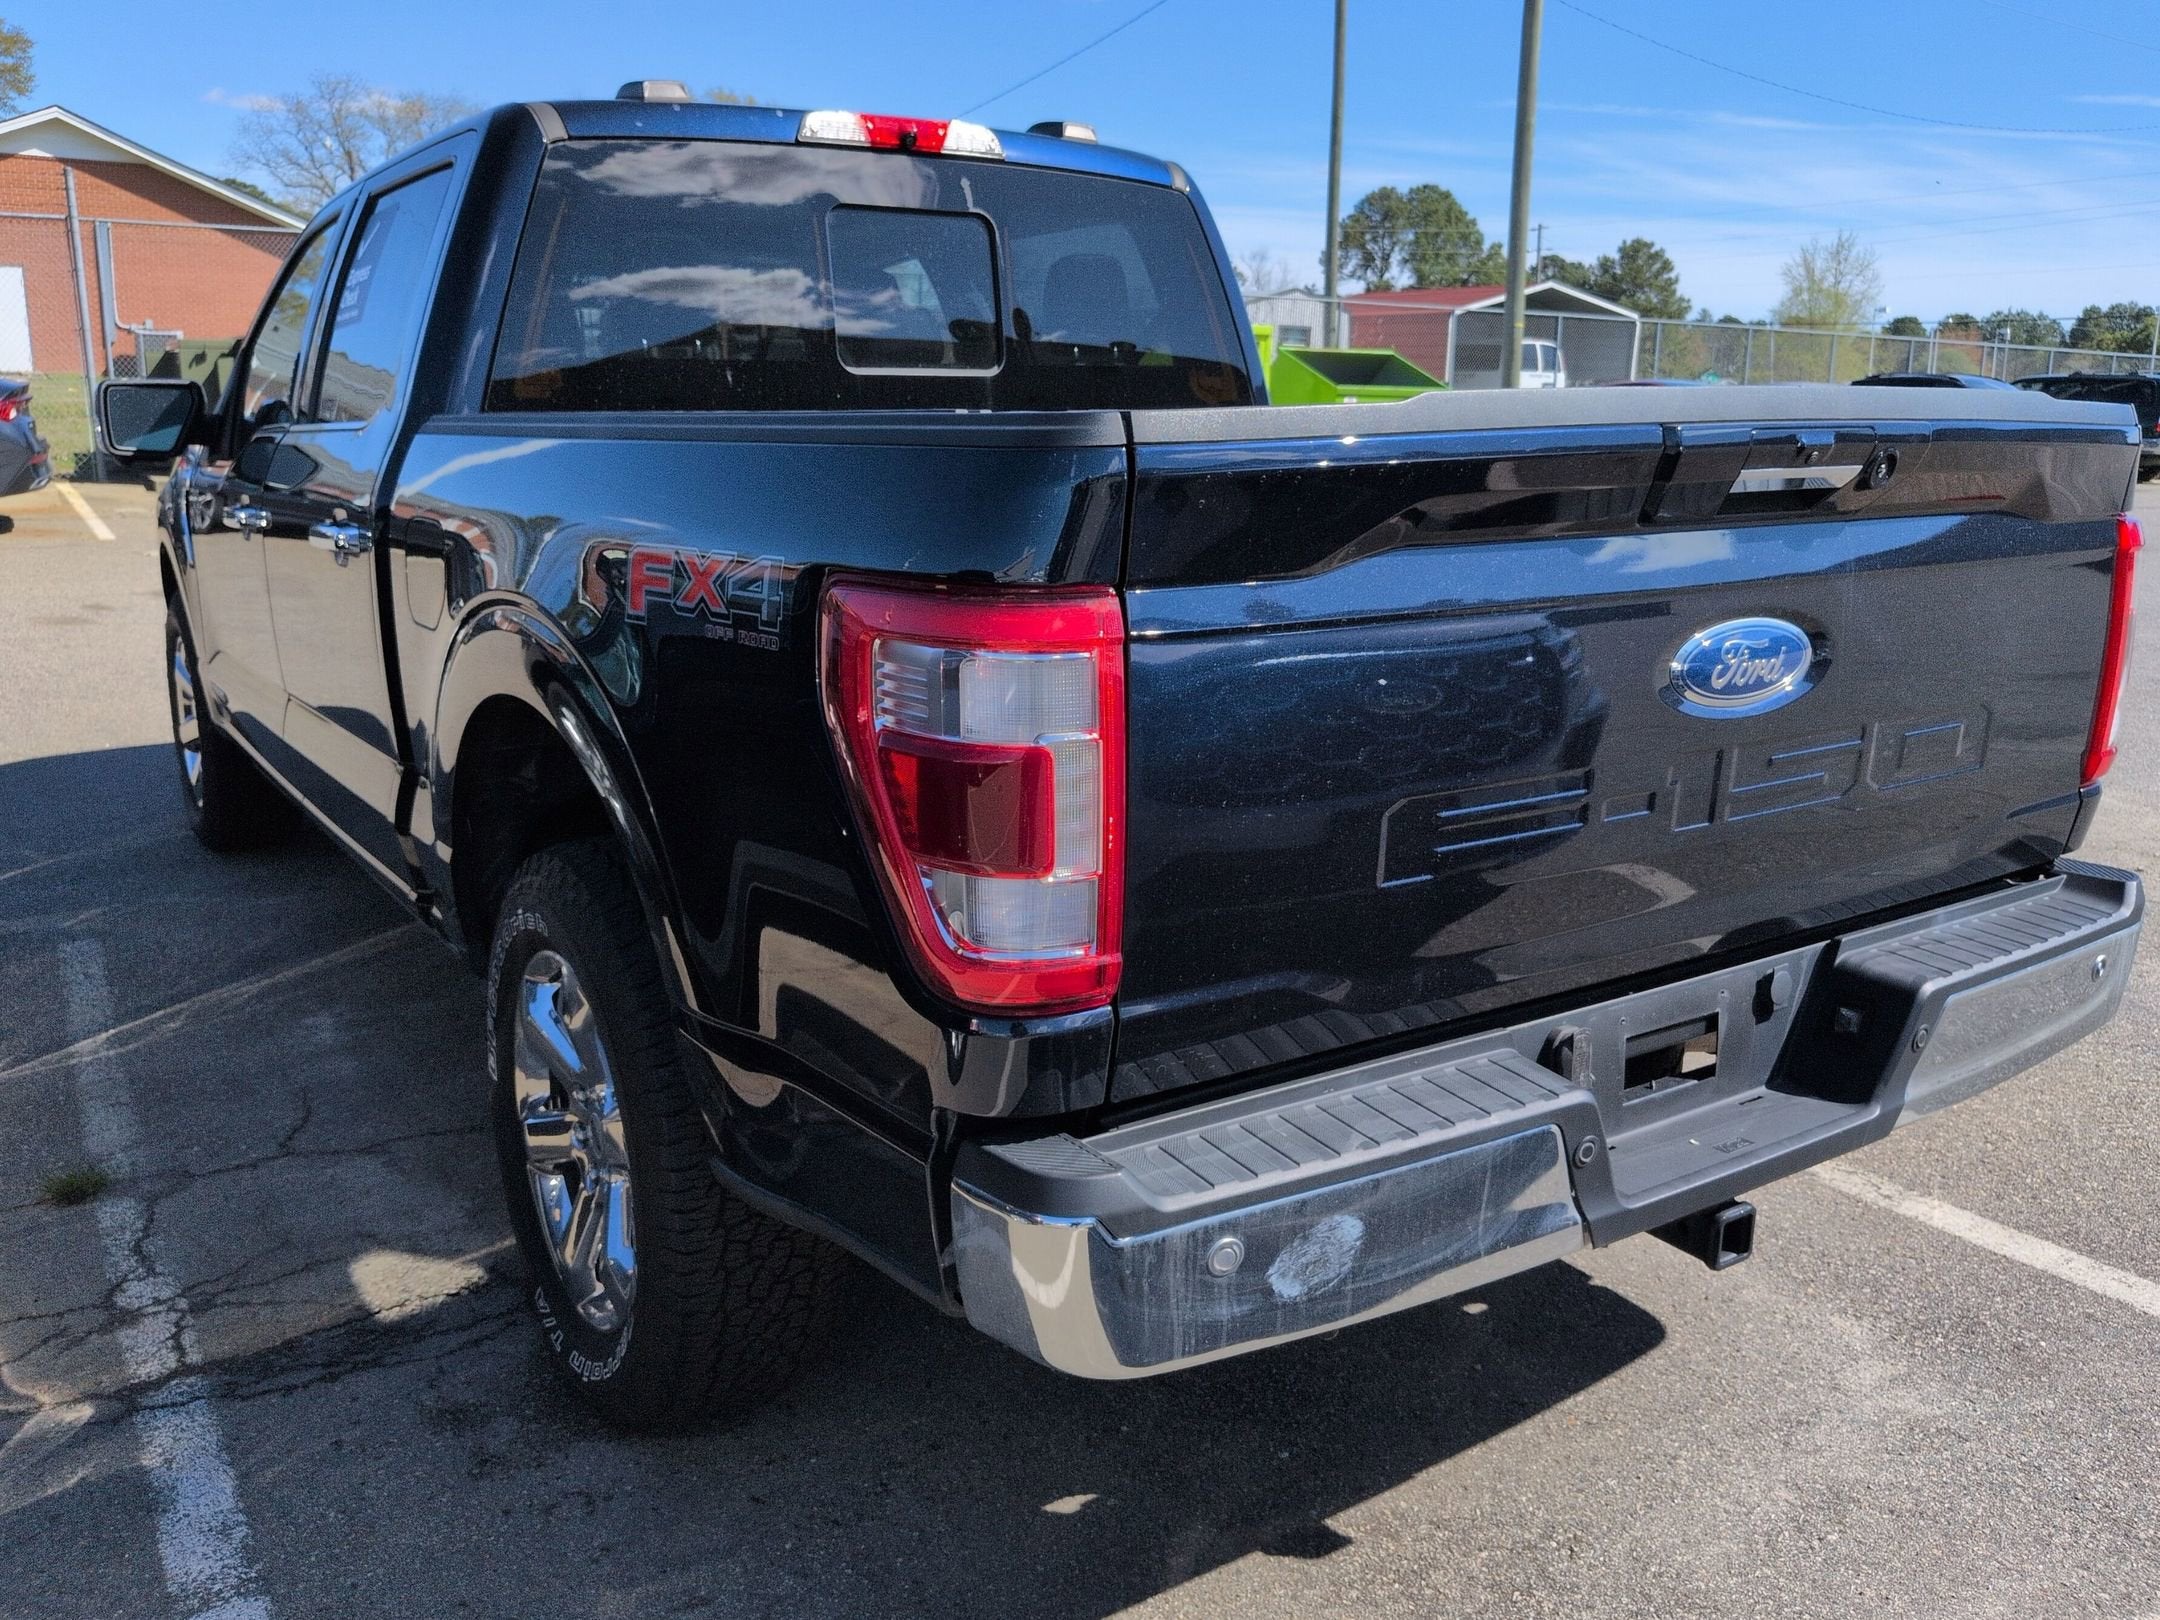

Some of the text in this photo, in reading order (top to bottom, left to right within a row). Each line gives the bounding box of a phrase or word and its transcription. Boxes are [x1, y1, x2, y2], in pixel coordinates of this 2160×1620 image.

[625, 542, 785, 632] FX4
[704, 624, 780, 651] OFF ROAD
[1711, 638, 1788, 690] Ford
[1378, 705, 1991, 889] F-150
